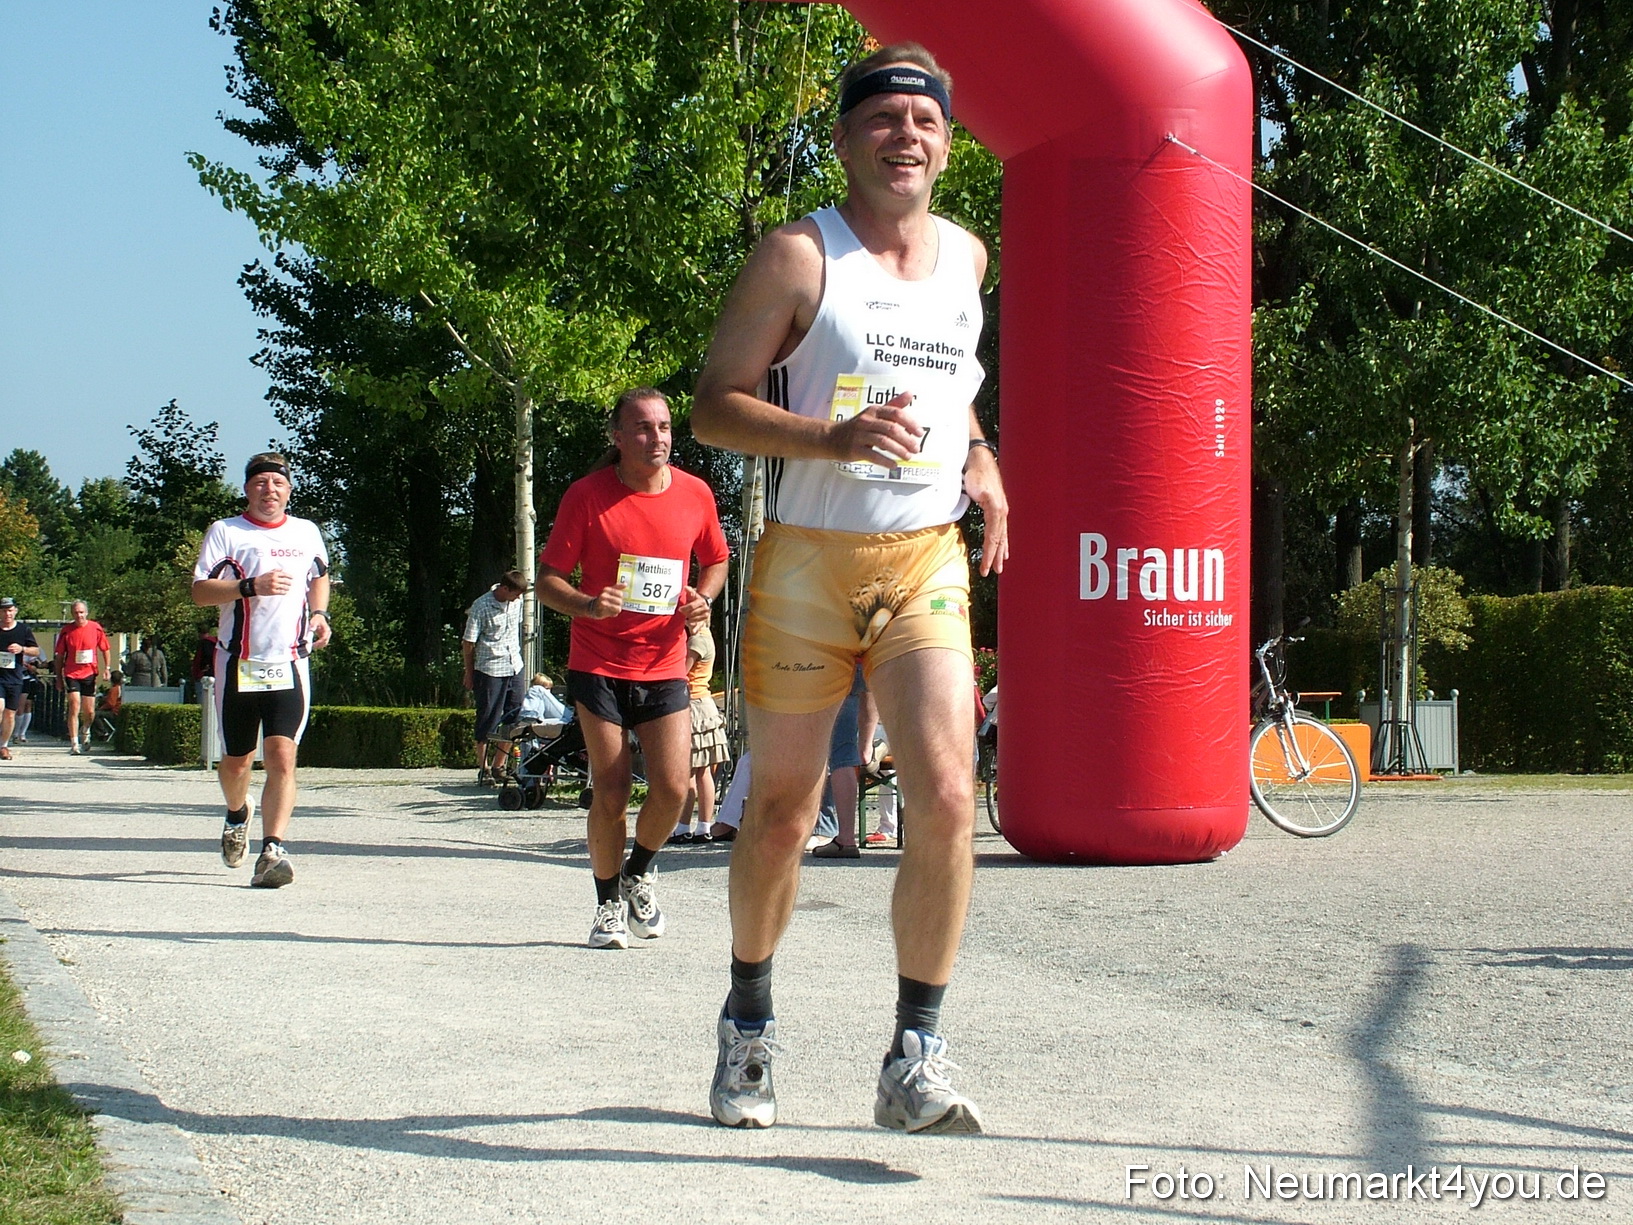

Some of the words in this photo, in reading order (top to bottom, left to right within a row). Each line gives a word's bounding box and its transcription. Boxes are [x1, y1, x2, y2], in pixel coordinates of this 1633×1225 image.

[866, 333, 895, 347] LLC
[899, 336, 964, 358] Marathon
[873, 349, 957, 375] Regensburg
[866, 385, 917, 406] Lothr
[1214, 398, 1225, 429] 1929
[1214, 434, 1225, 457] Seit
[270, 548, 304, 557] BOSCH
[637, 562, 672, 575] Matthias
[1079, 532, 1224, 602] Braun
[642, 582, 672, 599] 587
[1143, 608, 1184, 627] Sicher
[1188, 608, 1202, 627] ist
[1205, 609, 1233, 627] sicher
[258, 668, 284, 679] 366
